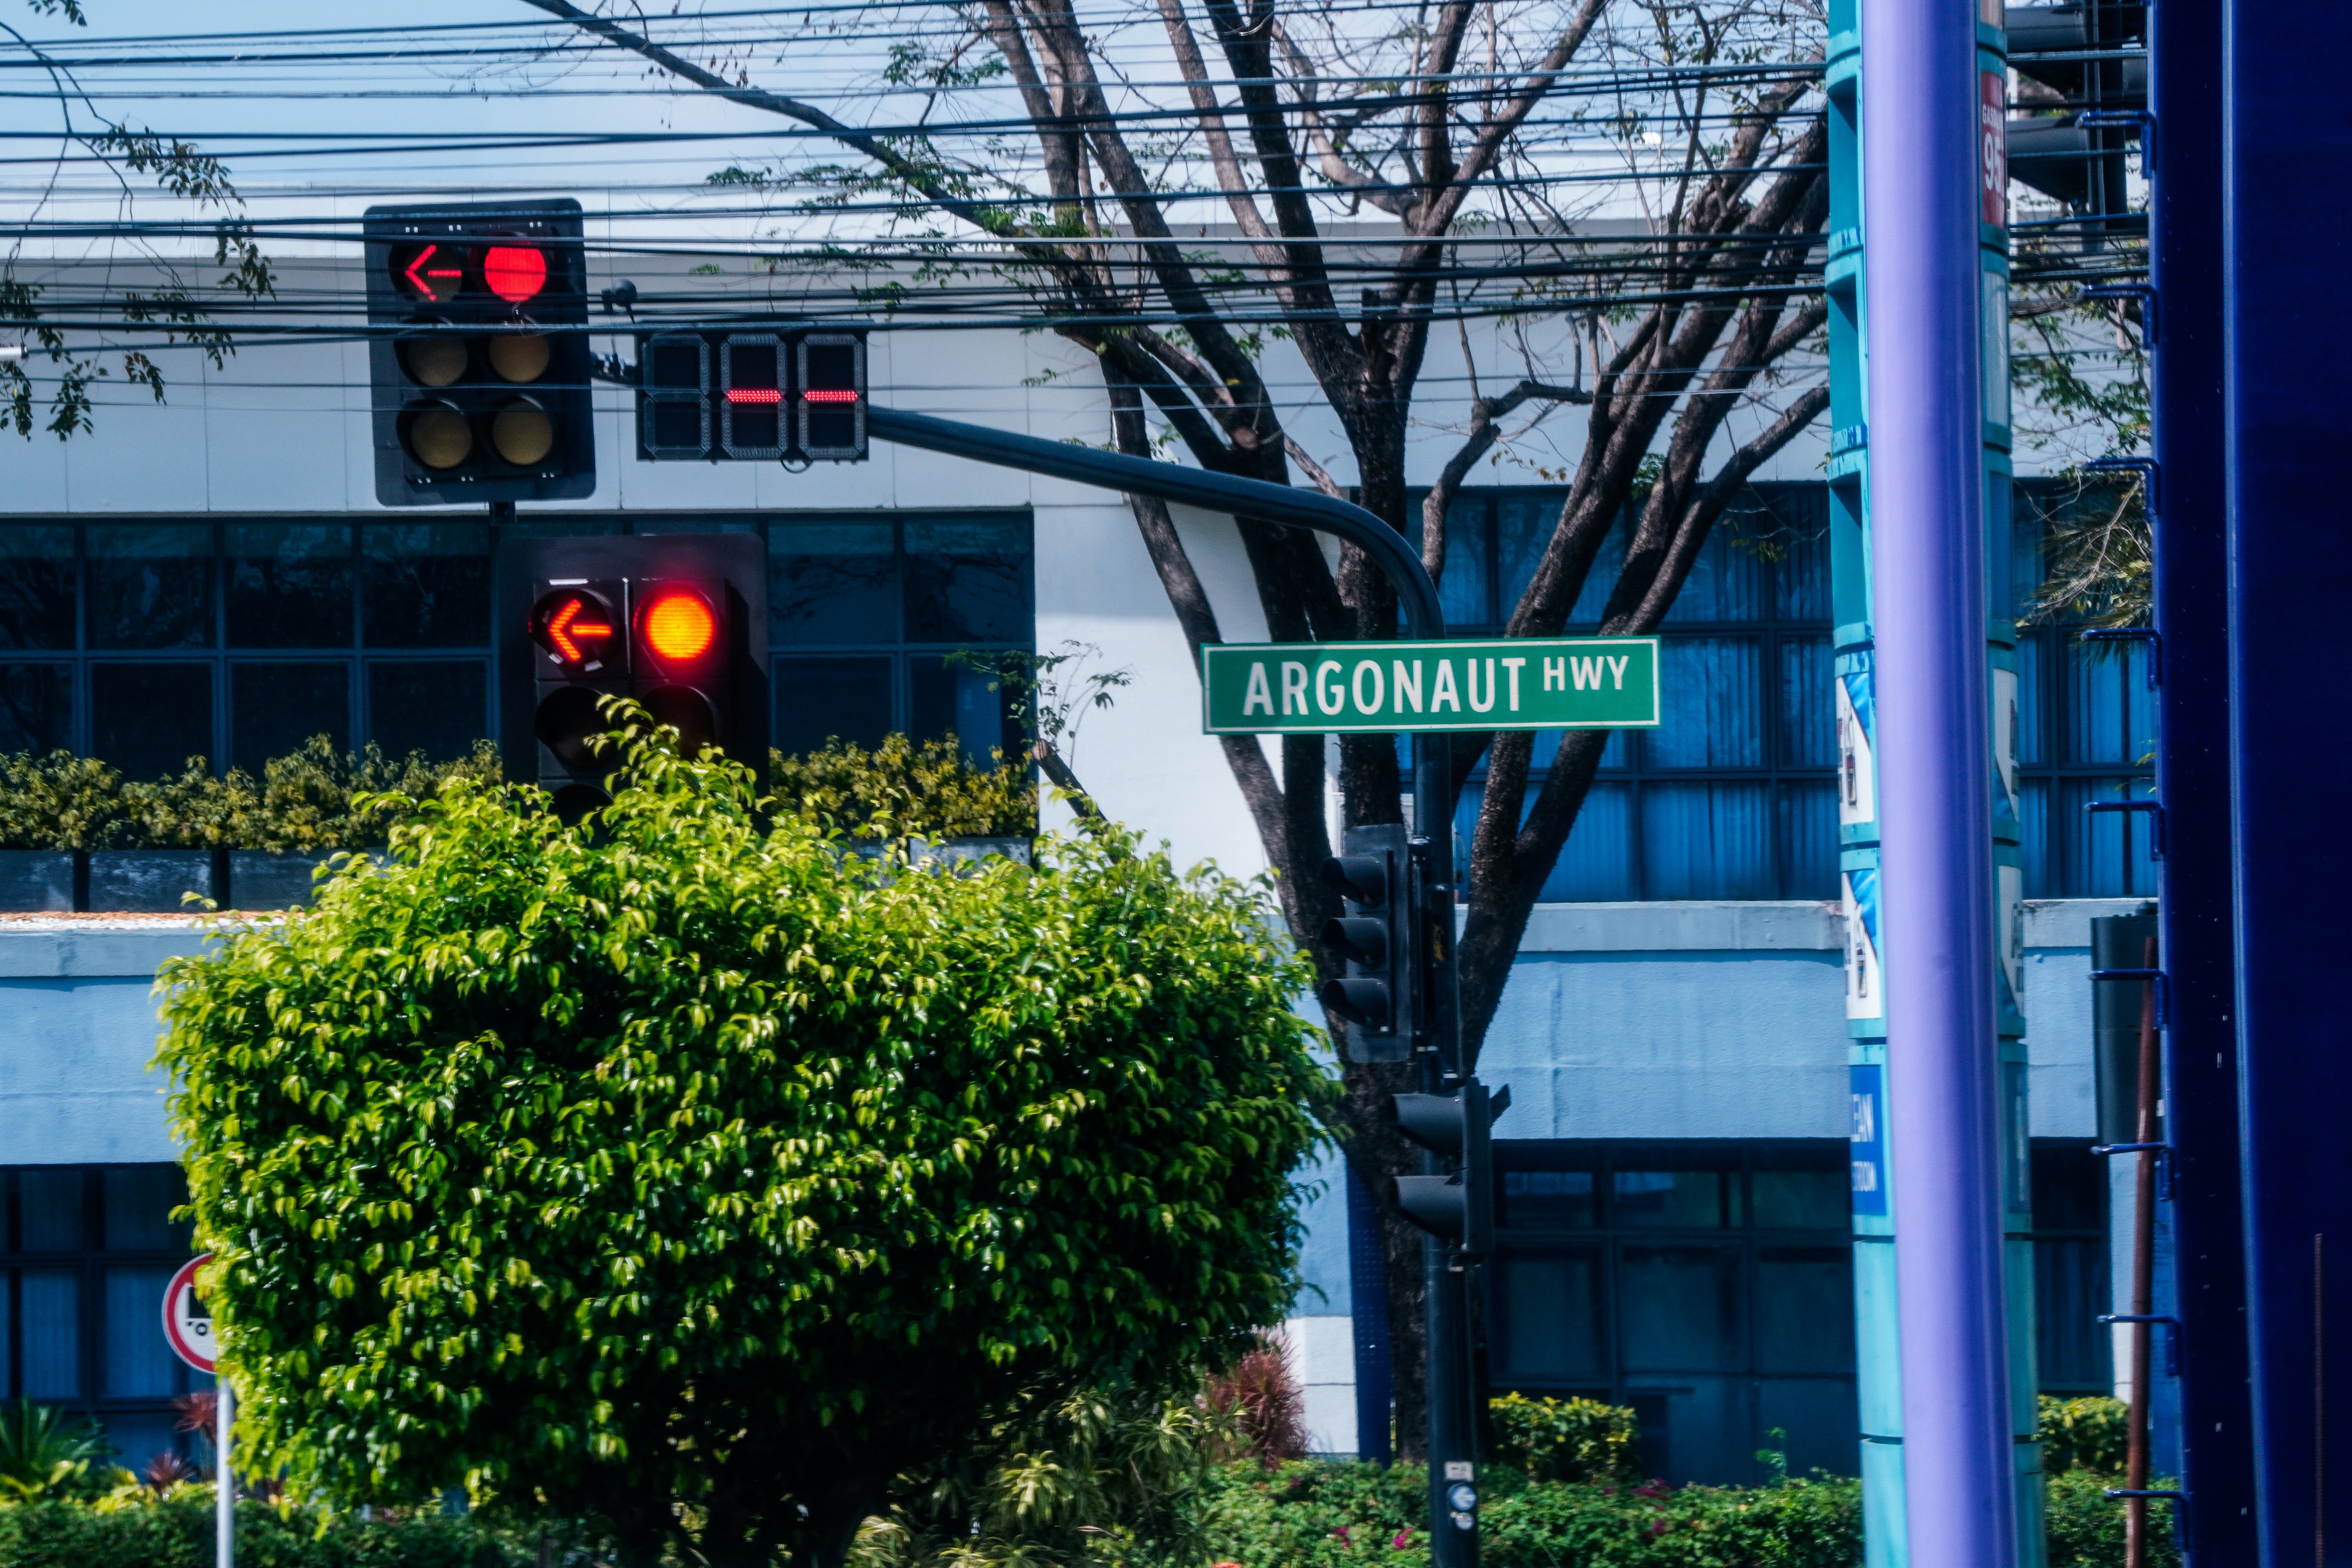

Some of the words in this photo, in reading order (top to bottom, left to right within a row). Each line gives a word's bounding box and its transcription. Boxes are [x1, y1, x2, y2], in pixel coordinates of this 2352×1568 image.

[1984, 131, 2003, 194] 95
[1243, 658, 1526, 716] ARGONAUT
[1543, 655, 1629, 691] HWY
